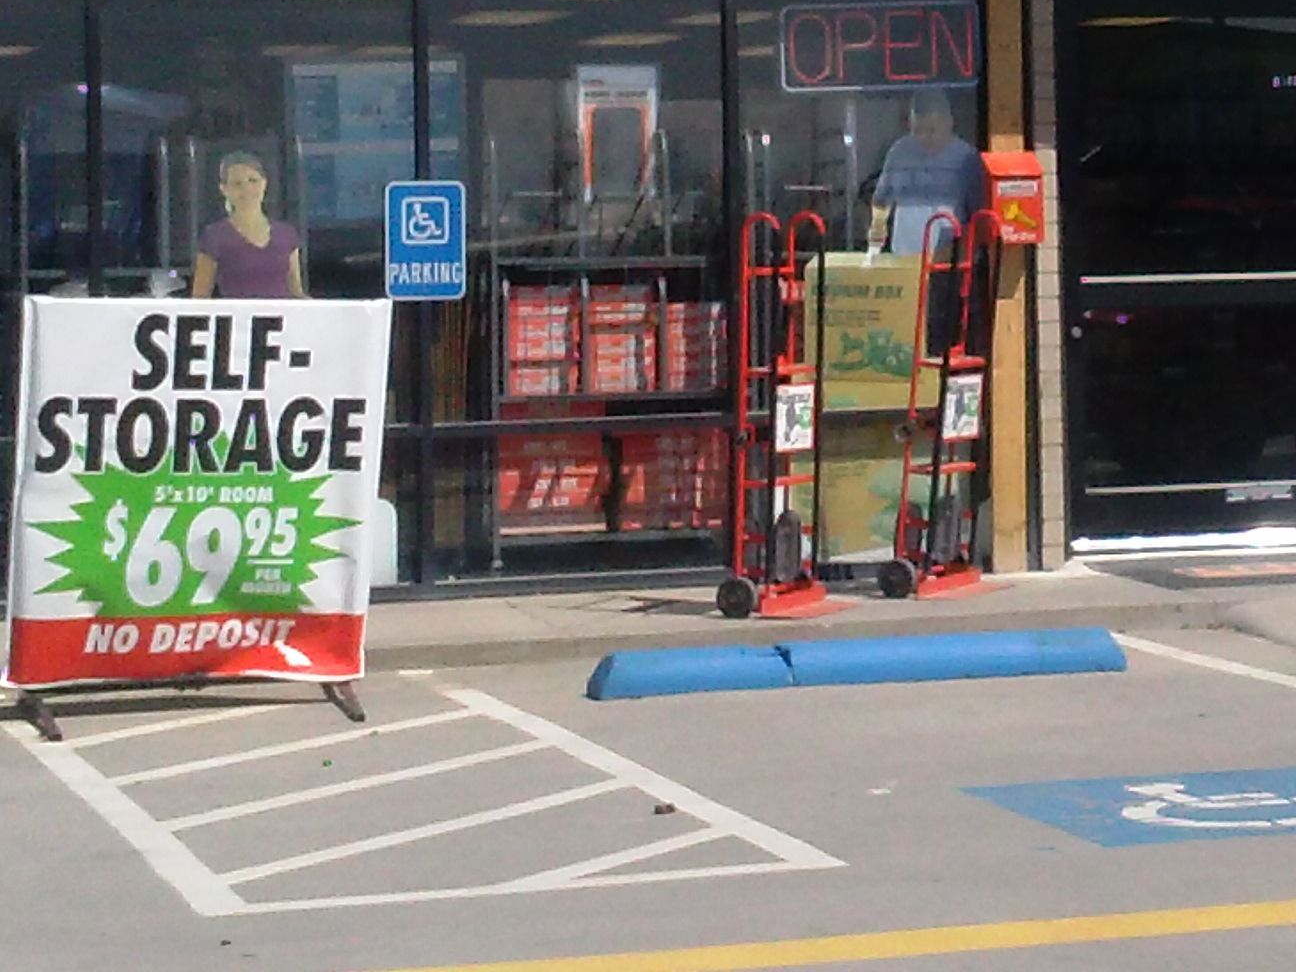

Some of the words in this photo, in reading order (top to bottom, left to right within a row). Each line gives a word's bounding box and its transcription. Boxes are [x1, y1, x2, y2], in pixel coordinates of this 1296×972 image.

[788, 8, 975, 84] OPEN
[389, 262, 462, 284] PARKING
[131, 314, 312, 391] SELF-
[34, 396, 367, 475] STORAGE
[219, 486, 273, 503] ROOM
[84, 625, 139, 655] NO
[149, 618, 297, 655] DEPOSIT
